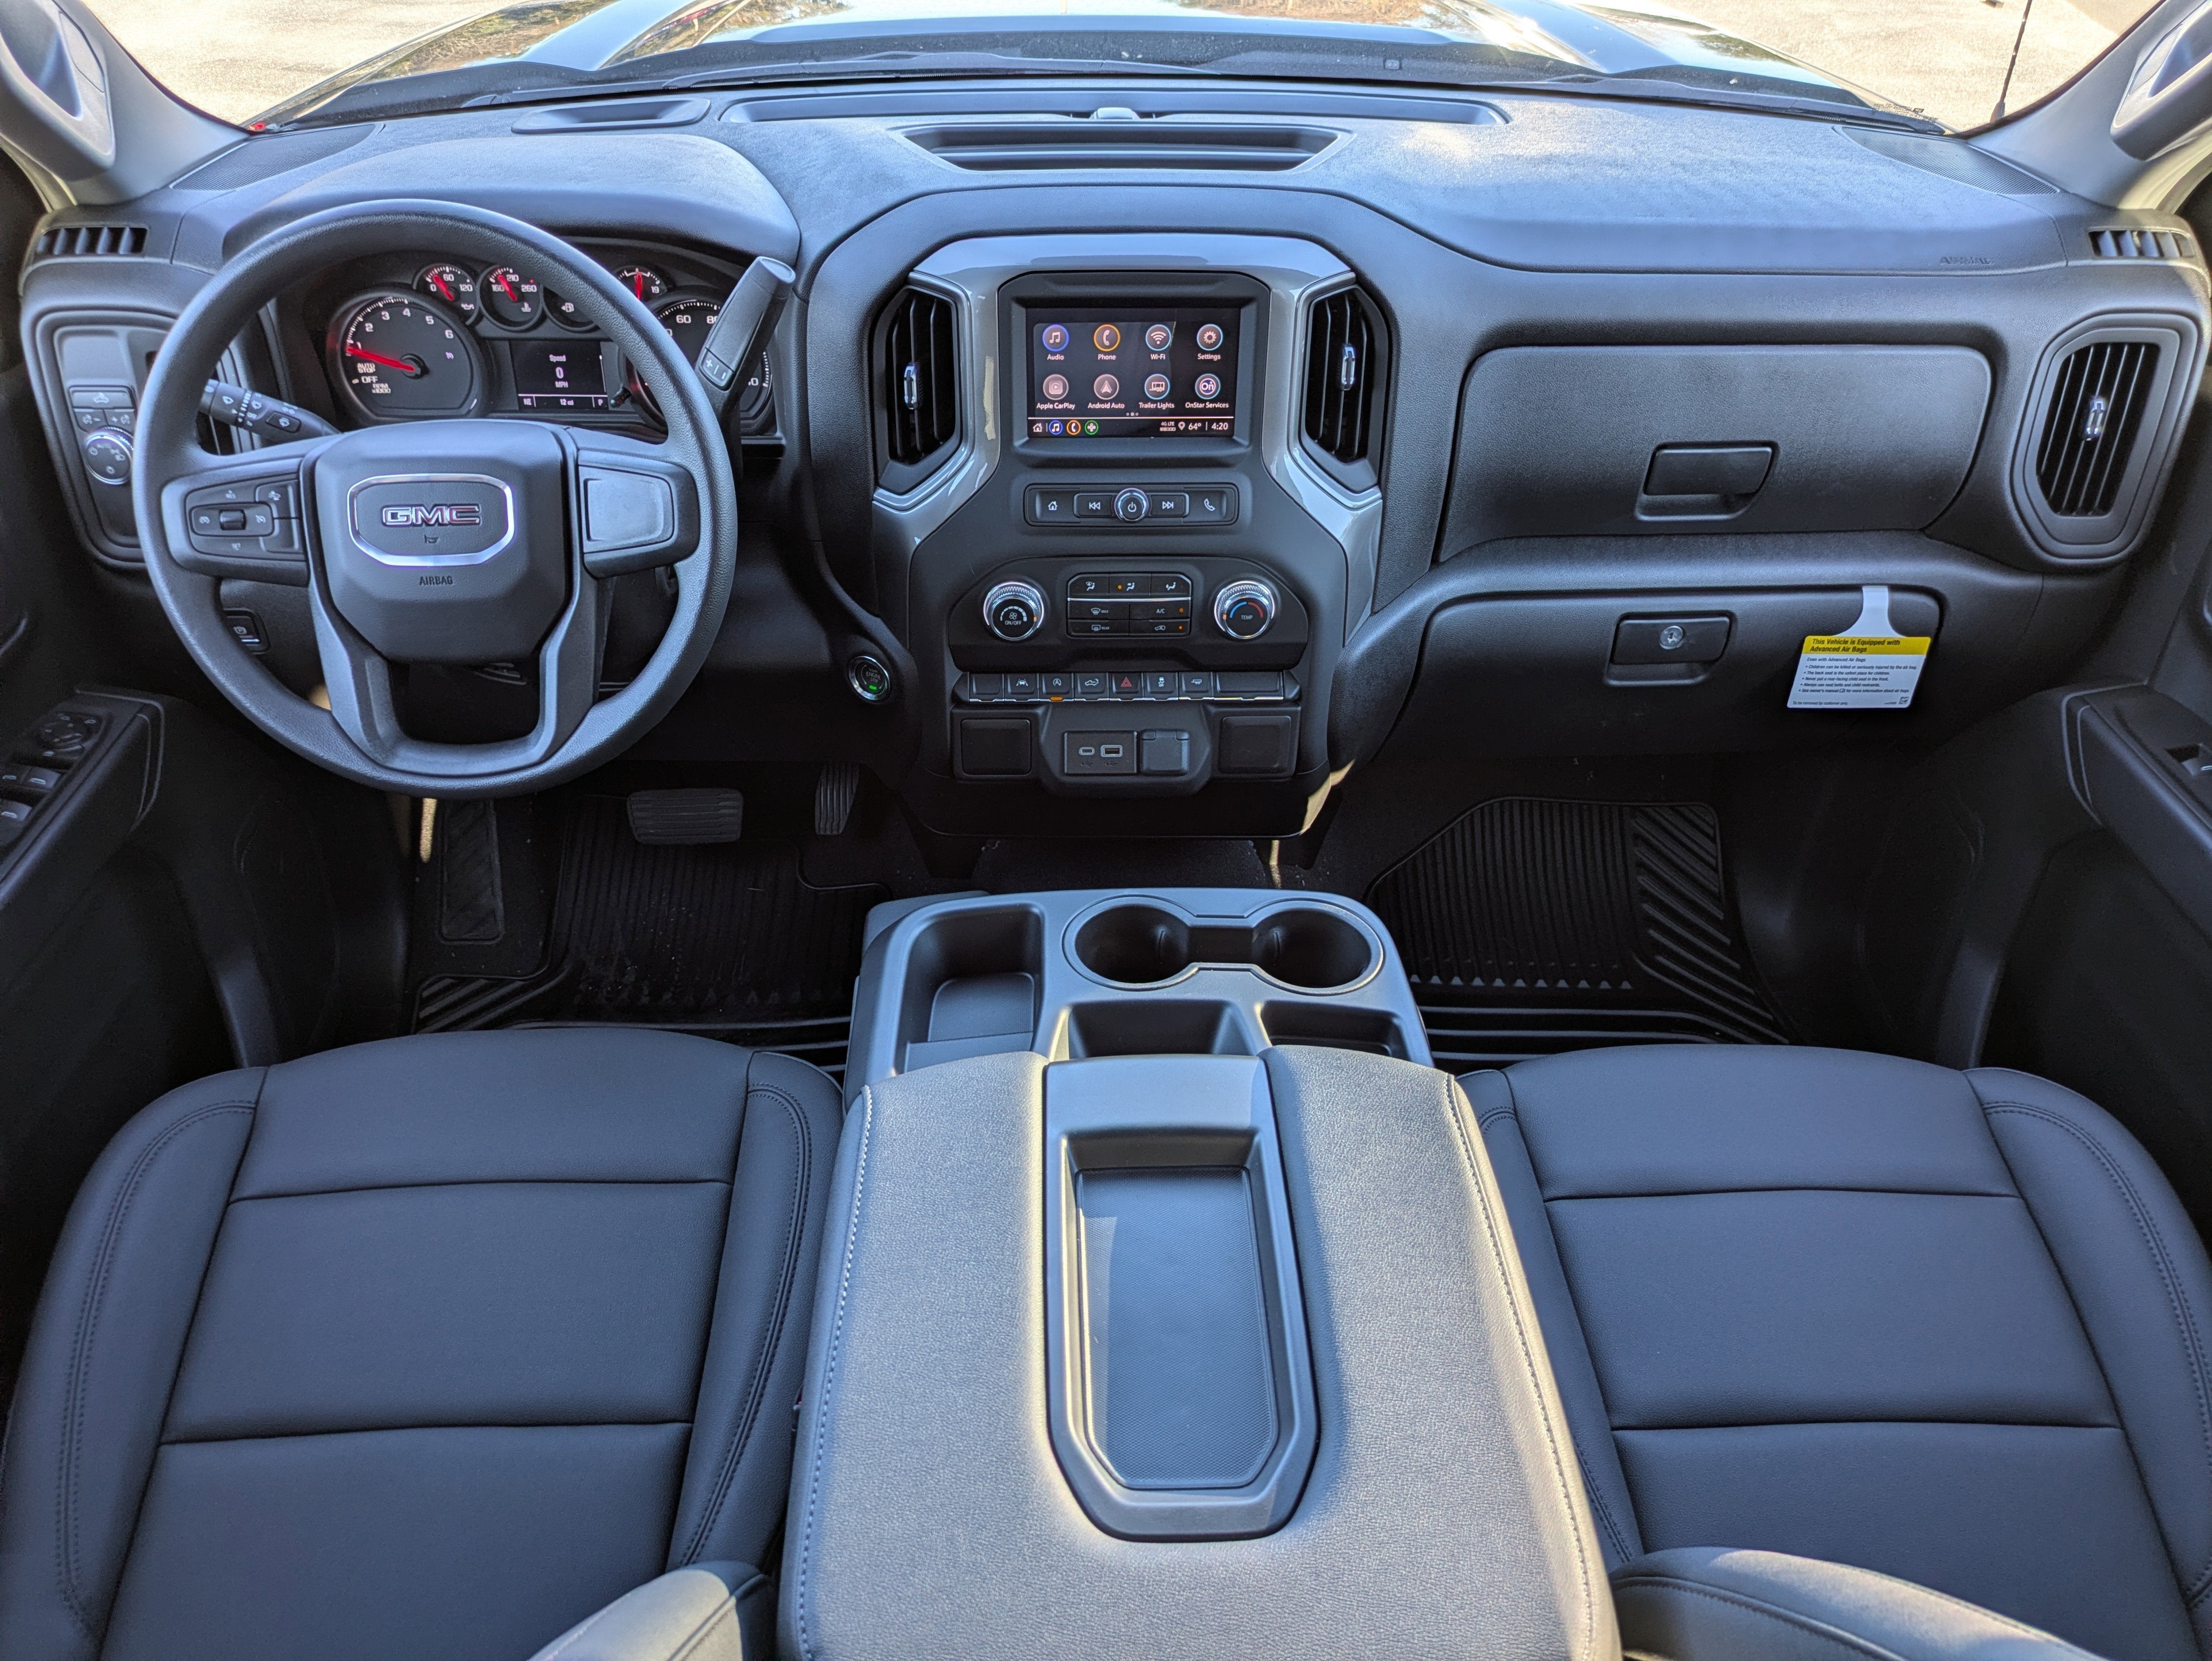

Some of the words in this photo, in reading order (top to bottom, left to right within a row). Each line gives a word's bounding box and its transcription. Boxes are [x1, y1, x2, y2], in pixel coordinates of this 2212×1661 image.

[459, 284, 473, 292] 120
[521, 284, 537, 292] 260
[381, 311, 390, 321] 3
[403, 308, 411, 317] 4
[425, 315, 434, 325] 5
[676, 315, 691, 323] 60
[365, 323, 374, 332] 2
[445, 329, 454, 339] 6
[549, 354, 566, 362] Speed
[1197, 353, 1221, 361] Settings
[555, 367, 564, 379] 0
[383, 504, 480, 526] GMC
[420, 576, 453, 586] AIRBAG
